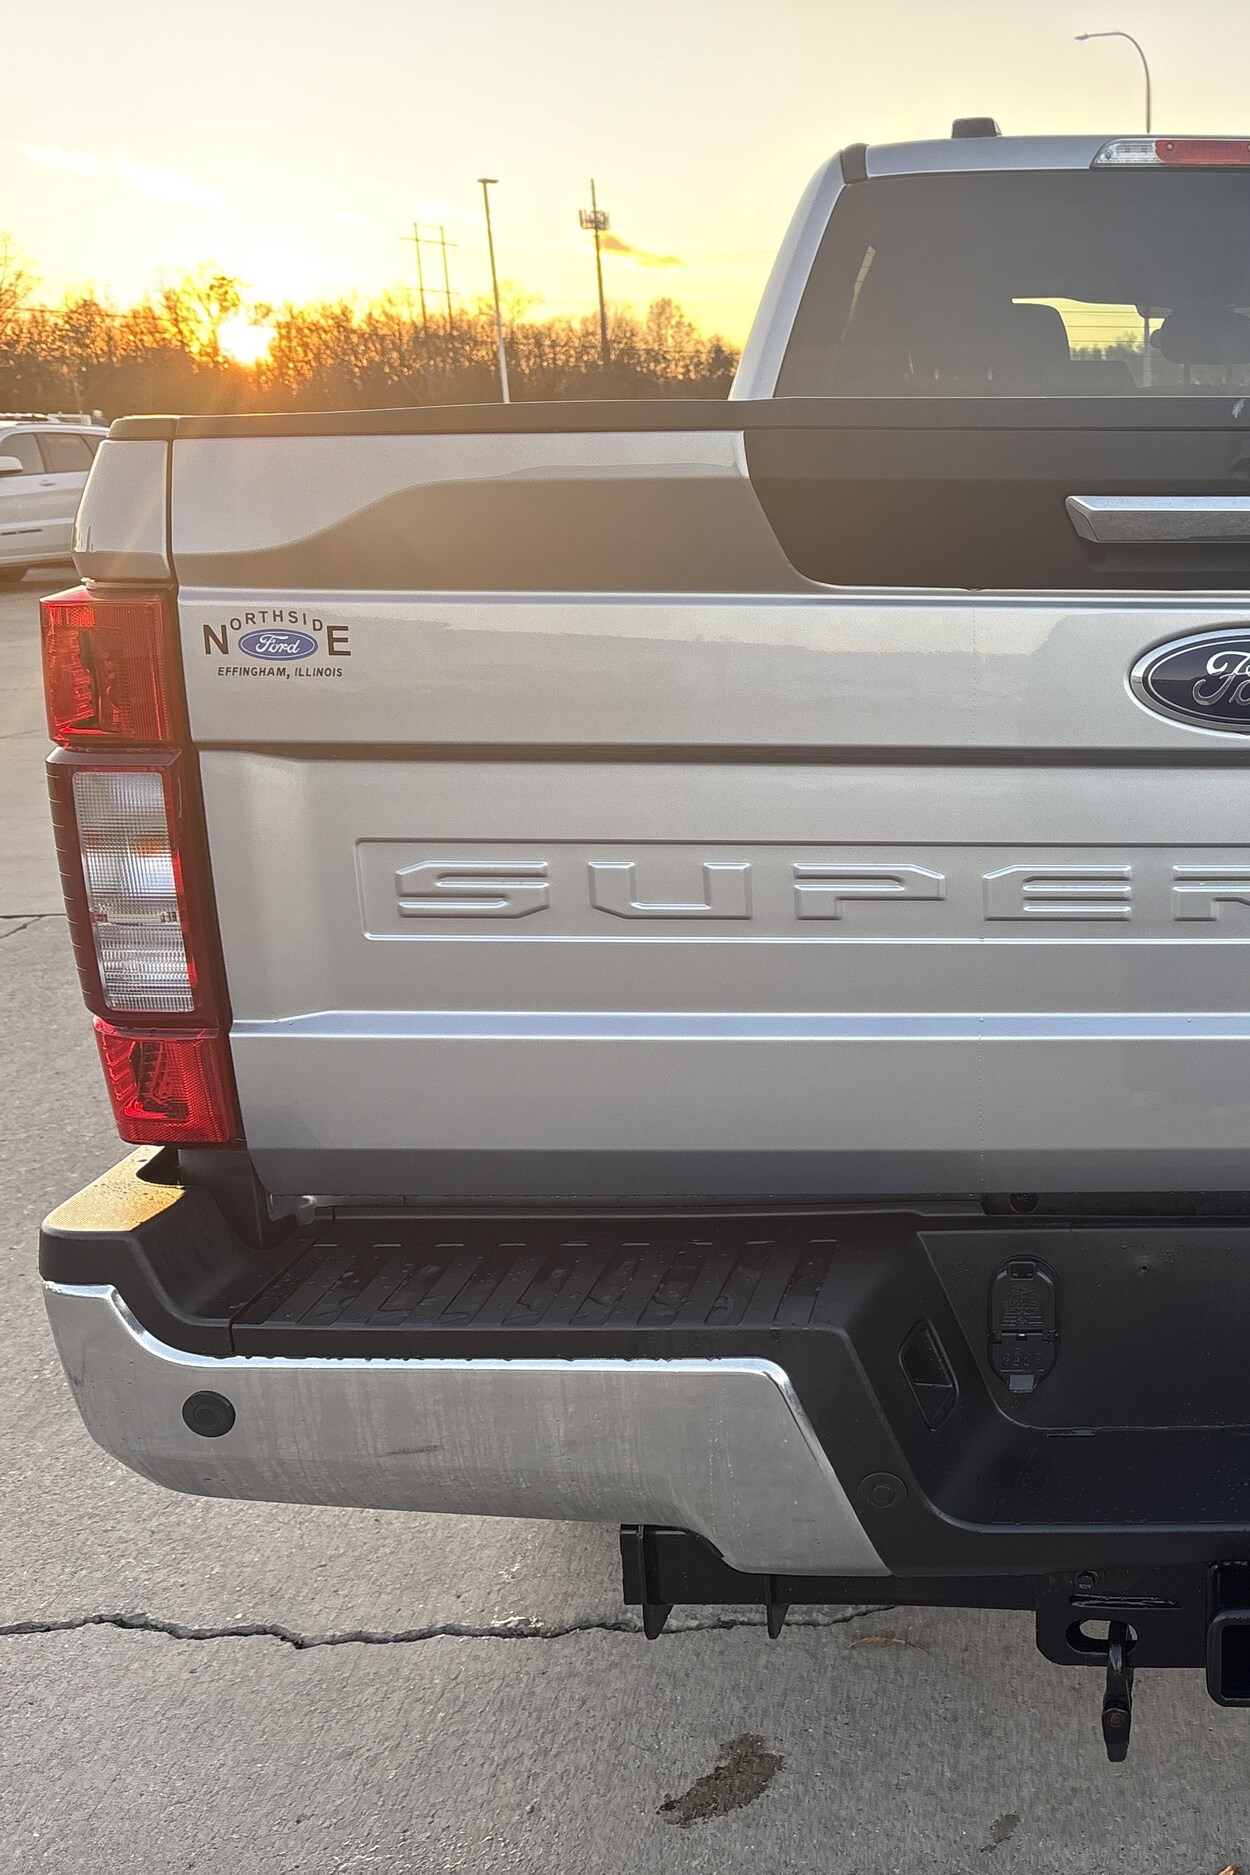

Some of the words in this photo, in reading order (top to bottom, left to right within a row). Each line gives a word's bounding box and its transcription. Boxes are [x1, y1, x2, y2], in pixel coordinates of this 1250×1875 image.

[203, 610, 351, 656] NORTHSIDE
[255, 634, 301, 654] Ford
[218, 667, 290, 680] EFFINGHAM,
[294, 667, 343, 677] ILLINOIS
